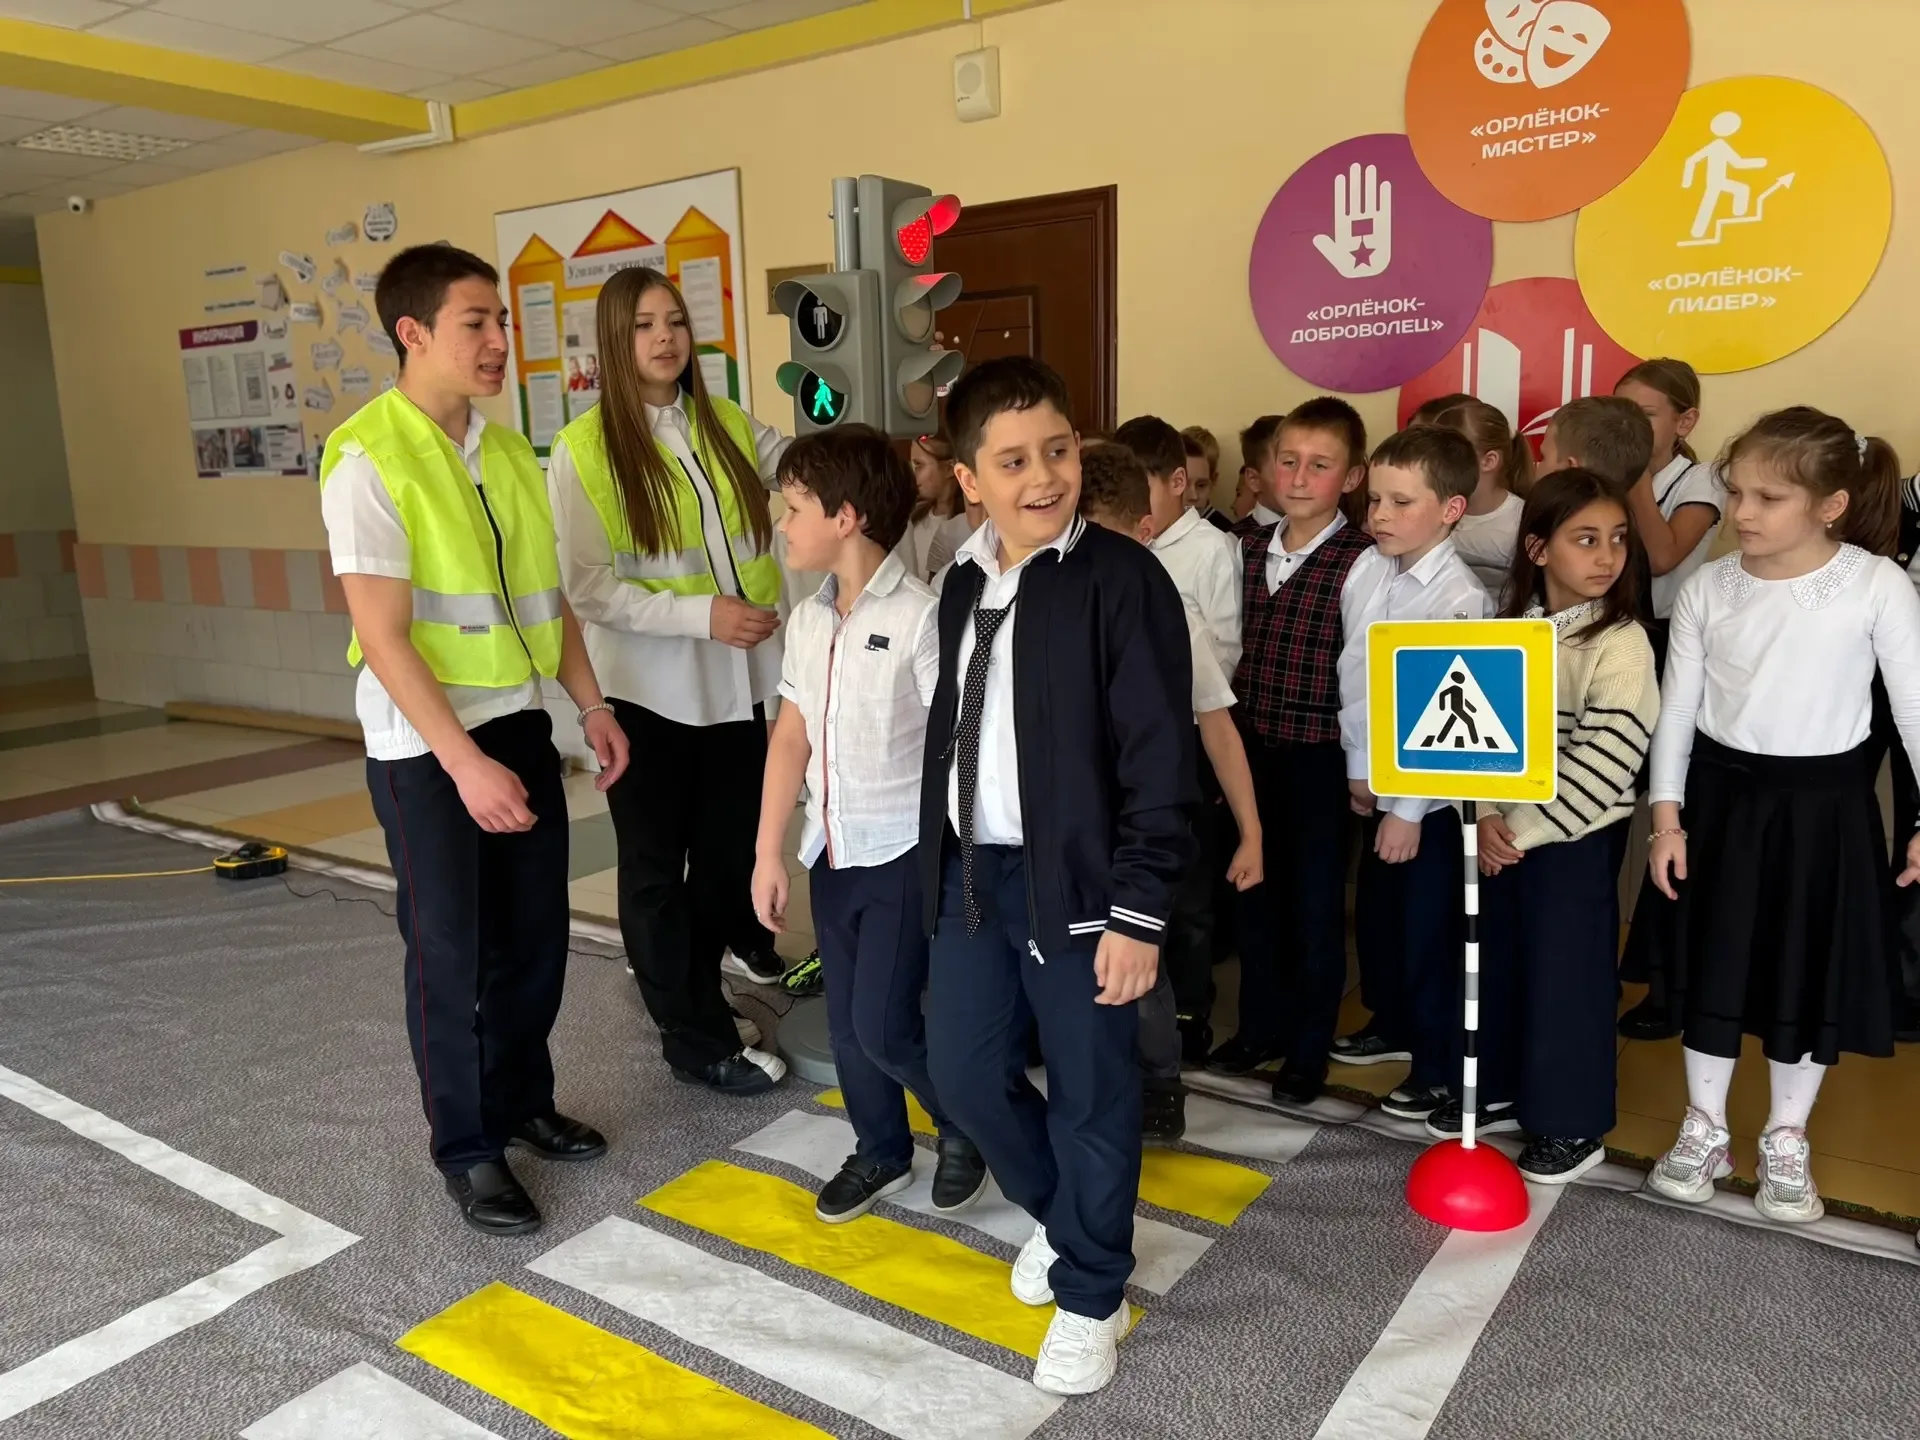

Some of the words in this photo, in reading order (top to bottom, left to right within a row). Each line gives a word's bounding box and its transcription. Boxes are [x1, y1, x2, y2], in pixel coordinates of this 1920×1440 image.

[1470, 102, 1610, 137] «ОРЛЁНОК-
[1482, 130, 1598, 159] МАСТЕР»
[1647, 265, 1802, 291] «ОРЛЁНОК-
[1305, 297, 1426, 321] «ОРЛЁНОК-
[1667, 292, 1778, 315] ЛИДЕР»
[1290, 317, 1445, 344] ДОБРОВОЛЕЦ»
